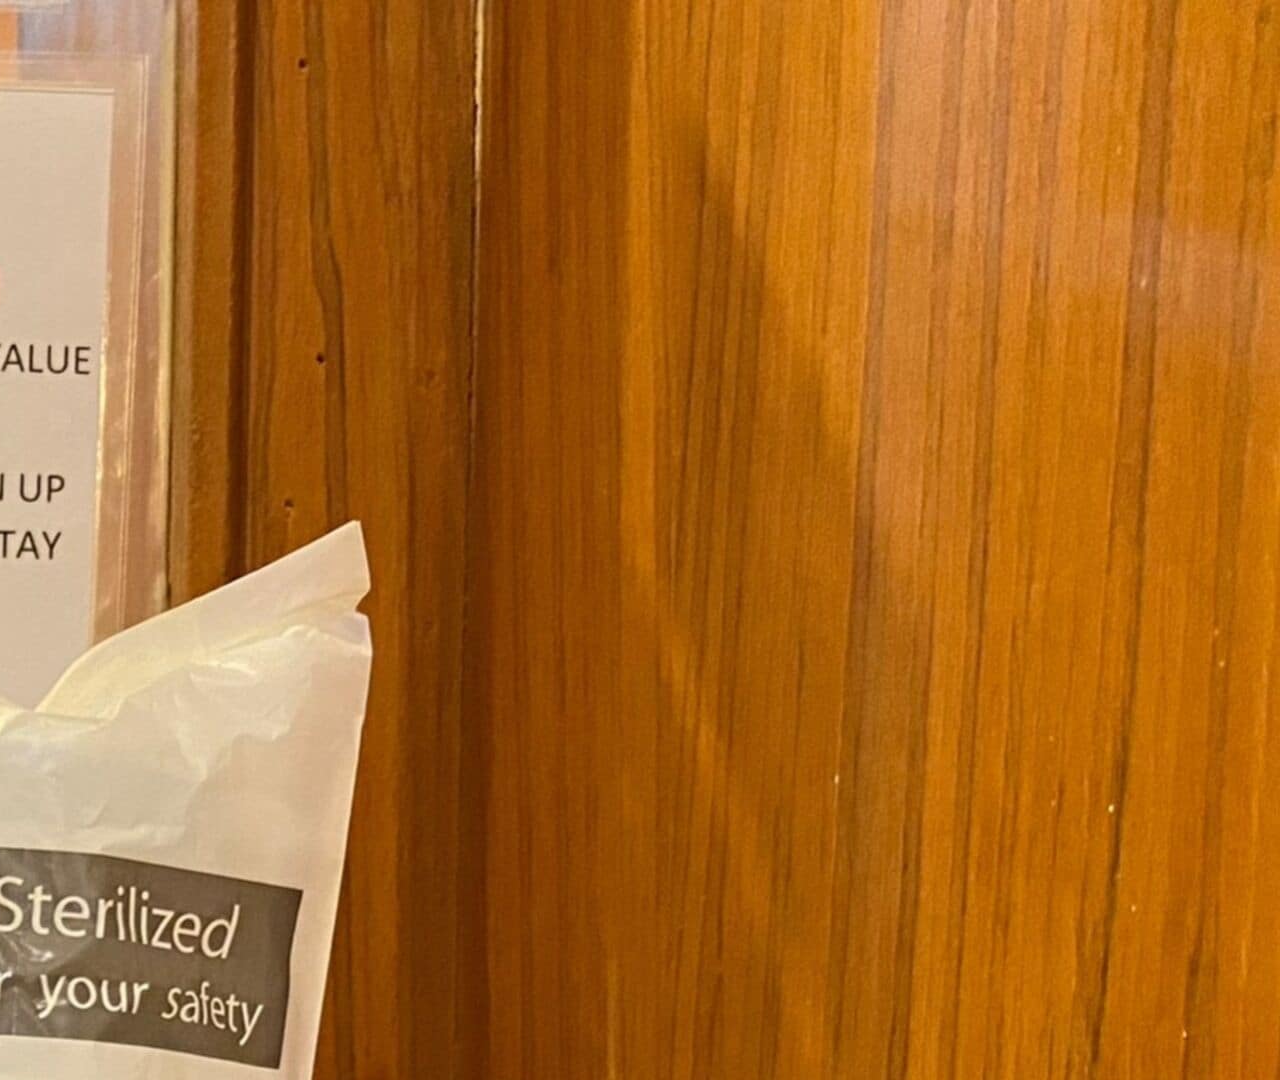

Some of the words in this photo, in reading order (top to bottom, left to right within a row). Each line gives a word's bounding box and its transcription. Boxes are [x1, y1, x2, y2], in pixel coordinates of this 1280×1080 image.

[19, 474, 66, 504] UP
[36, 972, 150, 1019] your
[160, 980, 265, 1047] safety
